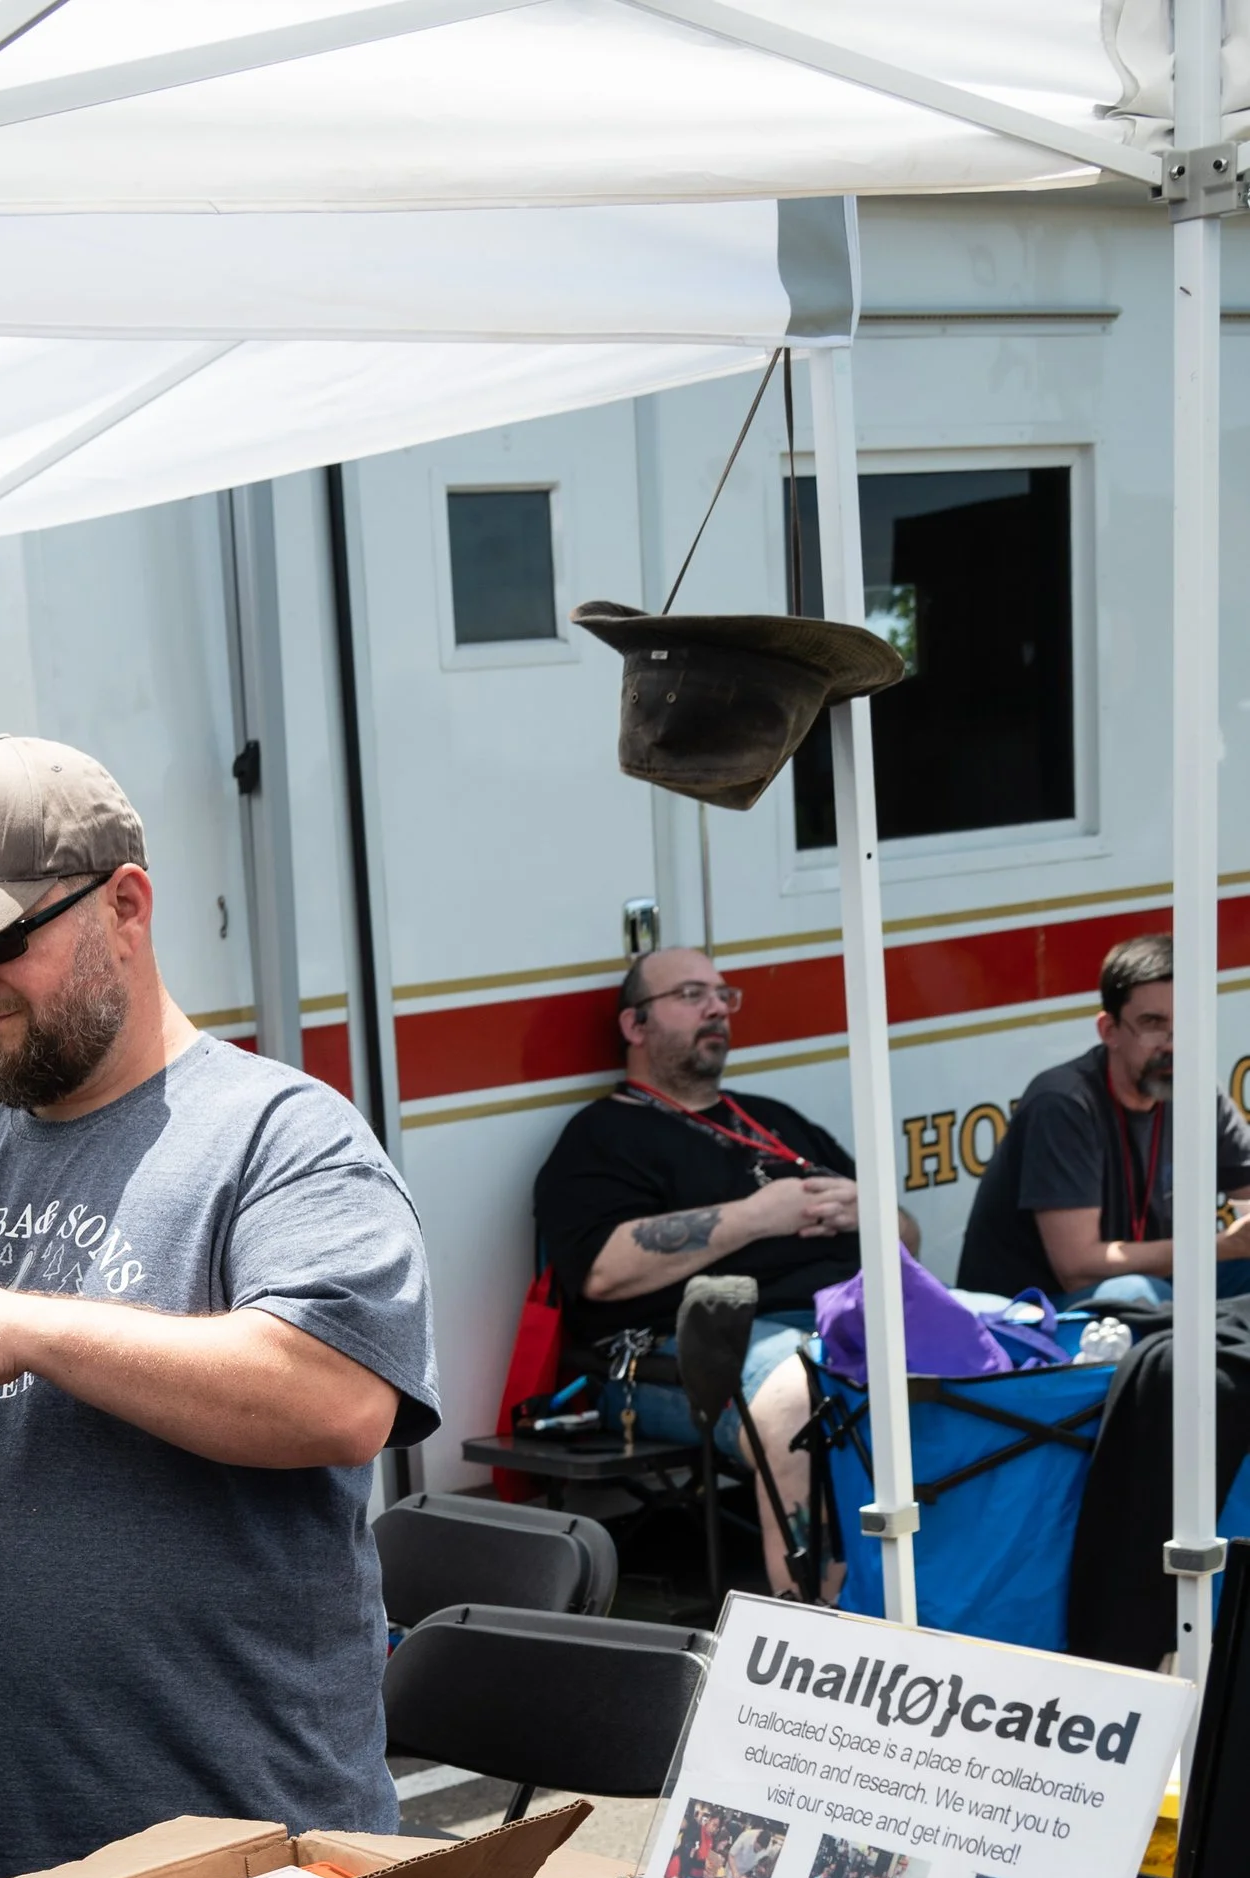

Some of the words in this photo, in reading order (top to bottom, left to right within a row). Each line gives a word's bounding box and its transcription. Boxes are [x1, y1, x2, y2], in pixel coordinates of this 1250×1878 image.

[738, 1705, 828, 1742] Unallocated
[829, 1725, 881, 1755] Space
[883, 1738, 898, 1759] is
[900, 1747, 913, 1763] a
[913, 1748, 962, 1774] place
[965, 1757, 990, 1780] for
[991, 1768, 1104, 1808] collaborative
[745, 1745, 817, 1776] education
[819, 1764, 853, 1784] and
[853, 1773, 927, 1804] research.
[936, 1786, 964, 1812] We
[968, 1800, 1012, 1825] want
[1011, 1811, 1049, 1834] you
[1052, 1817, 1070, 1839] to
[768, 1784, 795, 1807] visit
[796, 1795, 824, 1813] our
[824, 1802, 873, 1827] space
[875, 1815, 911, 1836] and
[910, 1824, 940, 1845] get
[942, 1827, 1022, 1865] involved!
